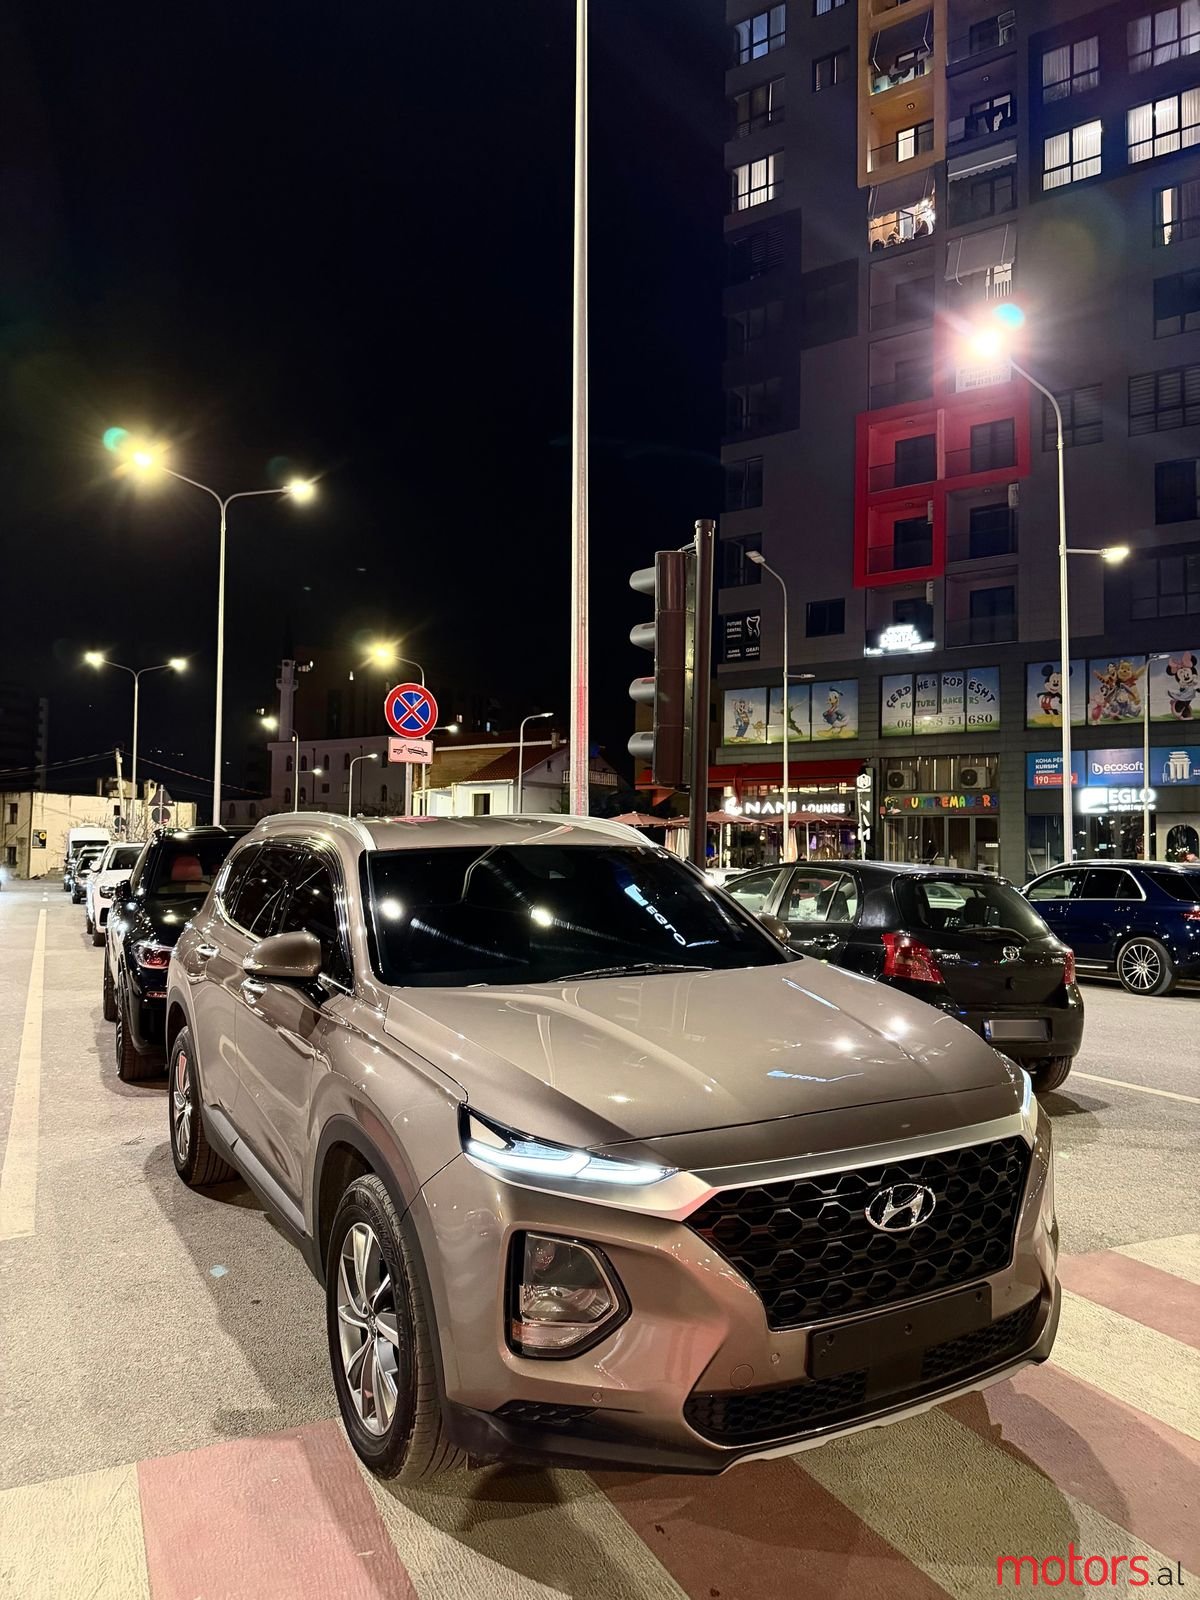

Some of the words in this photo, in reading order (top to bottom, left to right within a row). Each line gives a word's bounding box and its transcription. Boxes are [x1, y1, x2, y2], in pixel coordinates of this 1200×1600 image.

[942, 676, 996, 703] KOPËSHT
[900, 699, 936, 710] FUTURE
[942, 696, 980, 706] MAKERS
[968, 714, 993, 725] 680
[1103, 761, 1144, 772] ecosoft
[1035, 775, 1049, 784] 190
[1108, 788, 1157, 804] EGLO
[801, 803, 846, 814] LOUNGE
